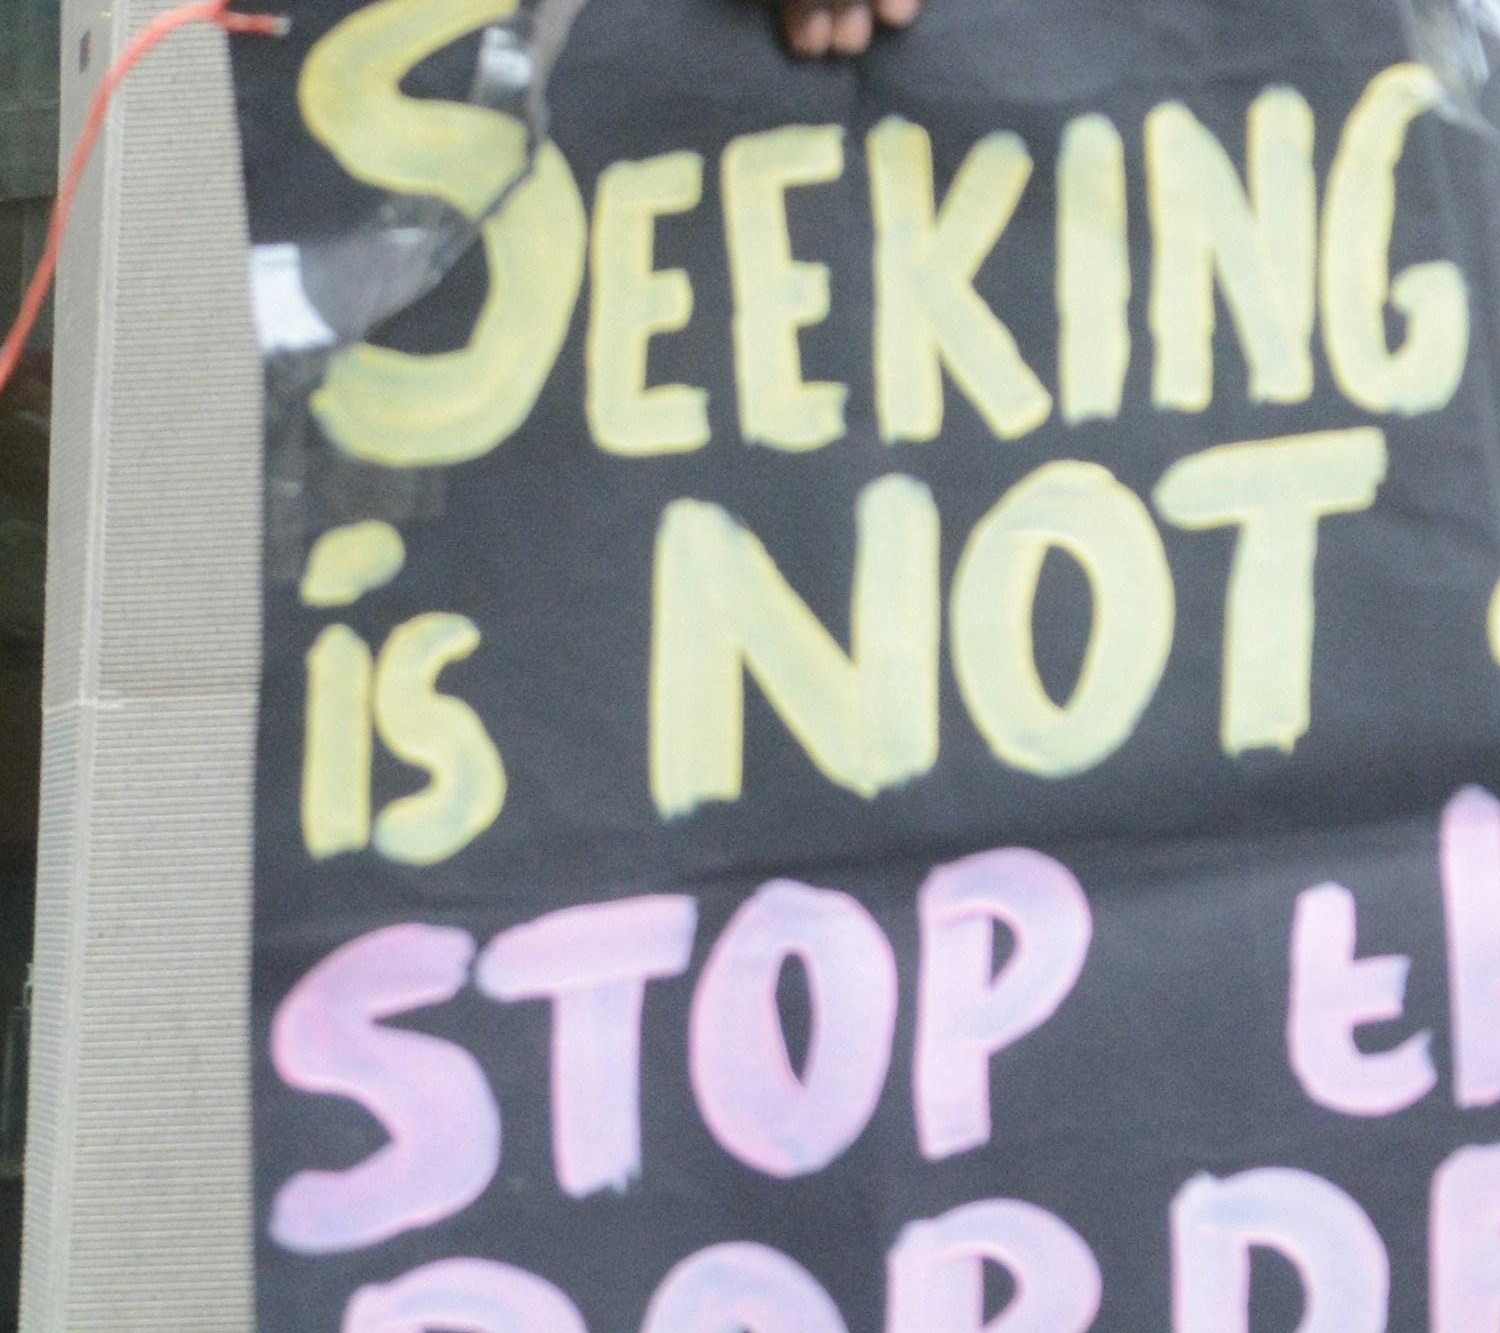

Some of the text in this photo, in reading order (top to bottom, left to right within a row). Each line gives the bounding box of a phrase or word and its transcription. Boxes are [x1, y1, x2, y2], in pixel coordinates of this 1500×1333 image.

[299, 519, 507, 865] is
[647, 426, 1387, 821] NOT
[268, 845, 1095, 1255] STOP
